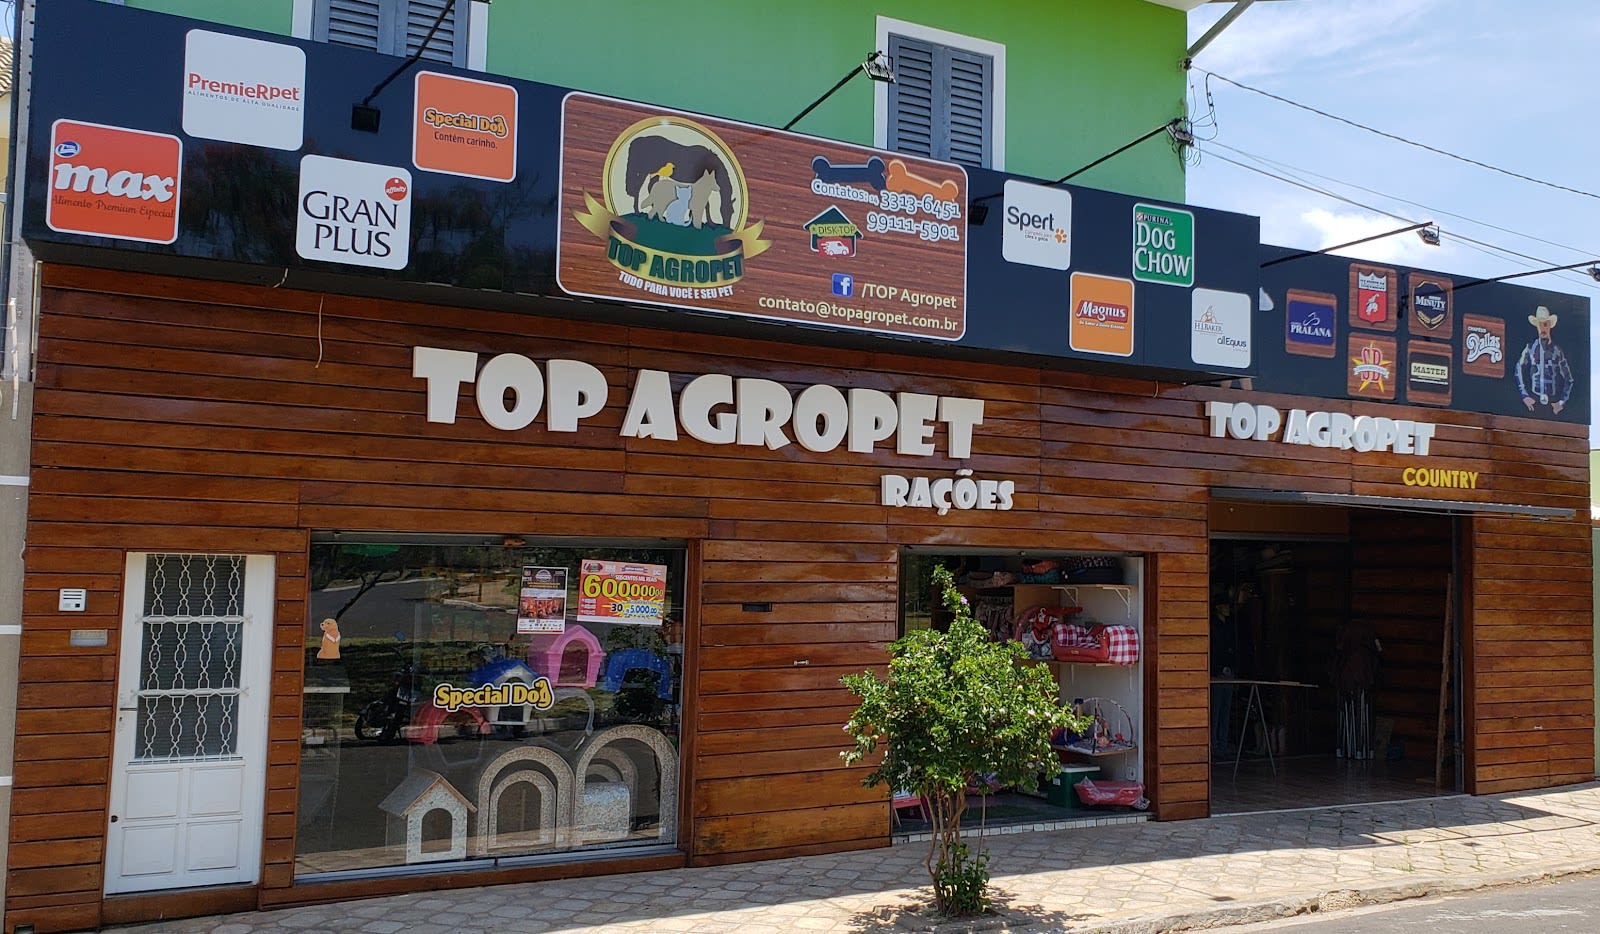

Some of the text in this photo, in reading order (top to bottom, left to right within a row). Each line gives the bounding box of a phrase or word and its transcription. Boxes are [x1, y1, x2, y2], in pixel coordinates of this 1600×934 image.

[188, 73, 300, 101] PremieRpet
[188, 90, 228, 102] ALIMENTOS
[262, 102, 300, 112] QUALIDADE
[425, 109, 507, 137] Special Dog
[434, 131, 498, 149] Contém carinho.
[54, 163, 175, 203] max
[95, 200, 136, 215] Premium
[139, 206, 175, 220] Especial
[303, 191, 398, 230] GRAN
[812, 179, 869, 202] Contatos:
[880, 189, 960, 220] 3313-6451
[867, 212, 960, 241] 99111-5901
[1007, 206, 1055, 232] Spert
[1143, 214, 1169, 225] PURINA
[315, 223, 391, 257] PLUS
[1136, 221, 1176, 250] DOG
[608, 236, 744, 284] TOP AGROPET
[1135, 247, 1191, 277] CHOW
[618, 271, 734, 299] TUDO PARA VOCÊ E SEU PET
[861, 282, 898, 300] /TOP
[900, 290, 958, 310] Agropet
[758, 296, 959, 331] contato@topagropet.com.br
[1075, 301, 1126, 321] Magnus
[1290, 324, 1332, 338] PRALANA
[1412, 365, 1446, 376] MASTER
[412, 346, 985, 459] TOP AGROPET
[1205, 401, 1435, 456] TOP AGROPET
[881, 468, 1015, 516] RAÇÕES
[1402, 467, 1479, 489] COUNTRY
[435, 678, 553, 711] Special Dog
